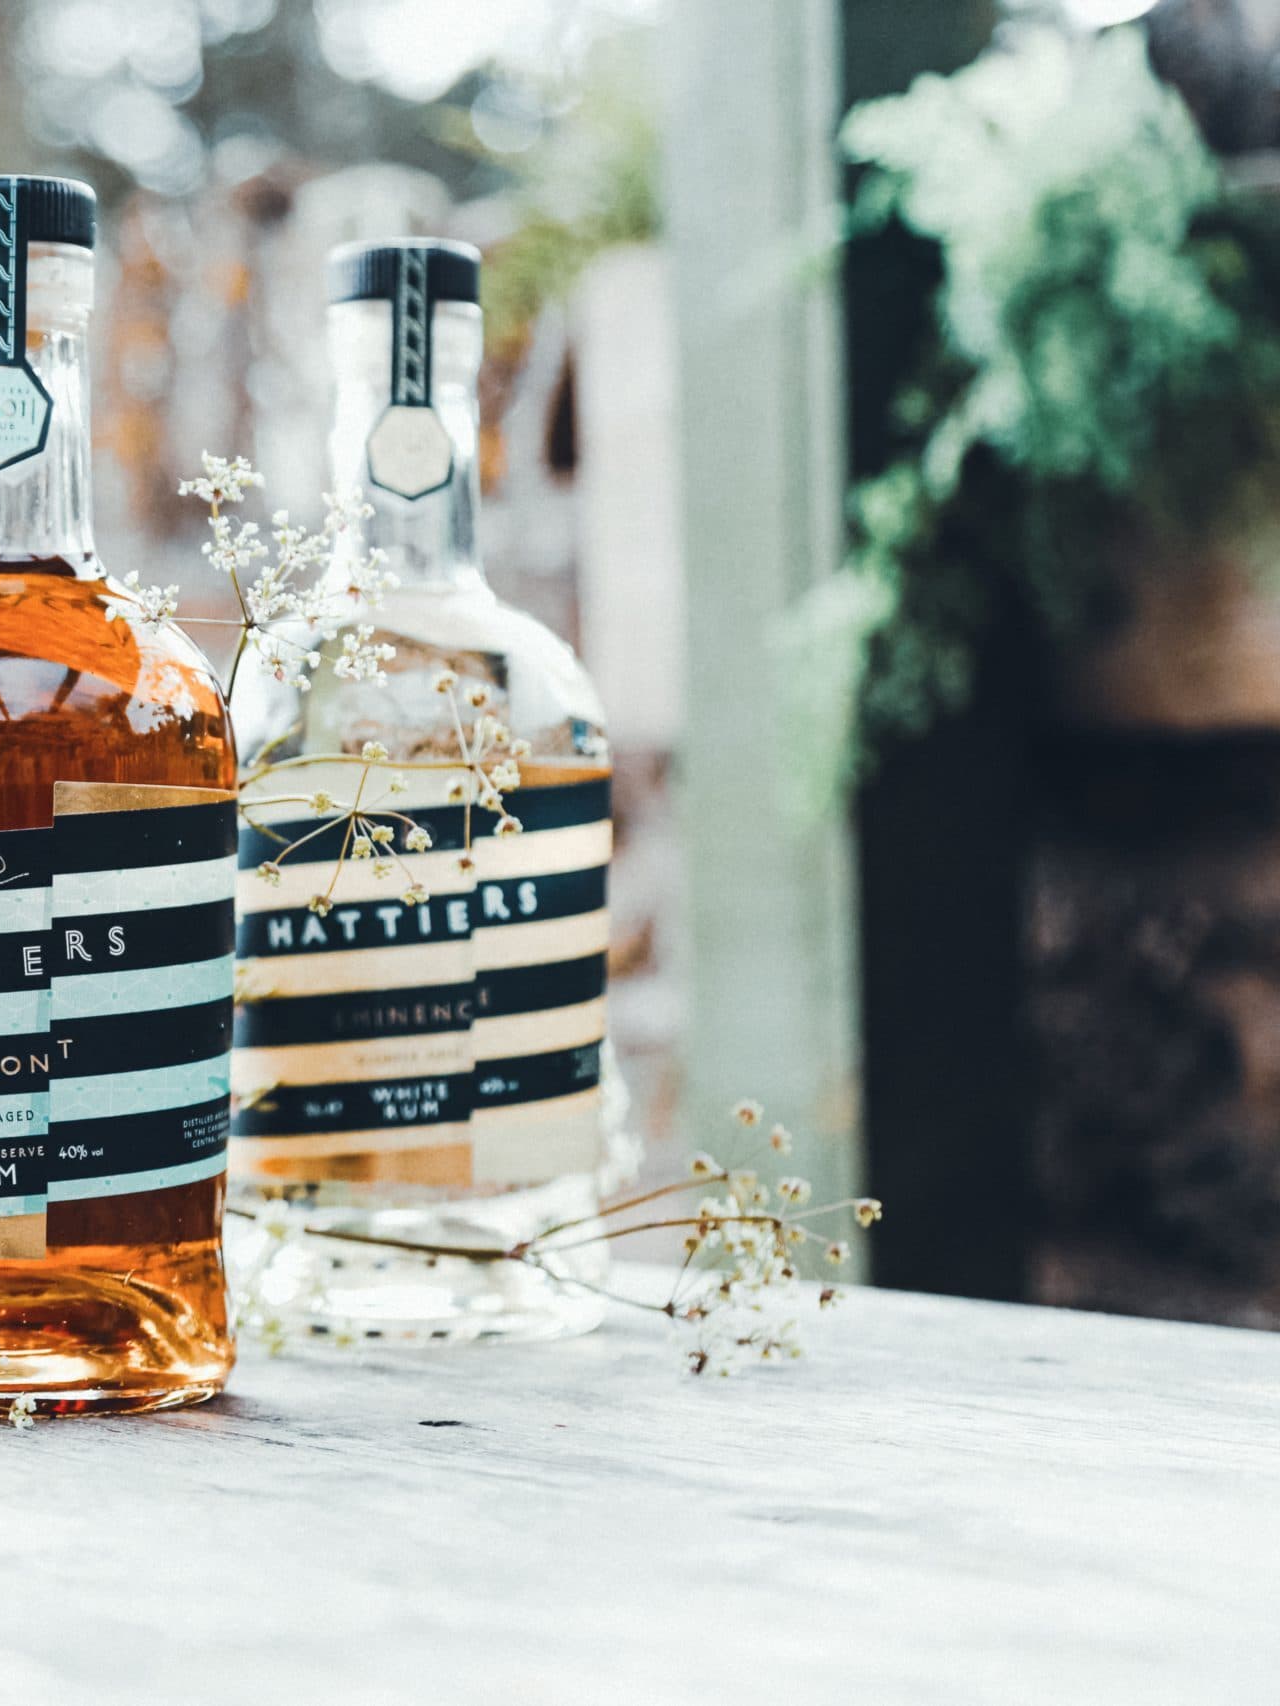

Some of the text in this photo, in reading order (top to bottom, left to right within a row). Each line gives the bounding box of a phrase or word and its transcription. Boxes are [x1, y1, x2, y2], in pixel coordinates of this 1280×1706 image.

[266, 881, 539, 949] HATTIERS
[370, 1080, 449, 1103] WHITE
[382, 1101, 439, 1120] RUM
[58, 1144, 104, 1161] 40% vol
